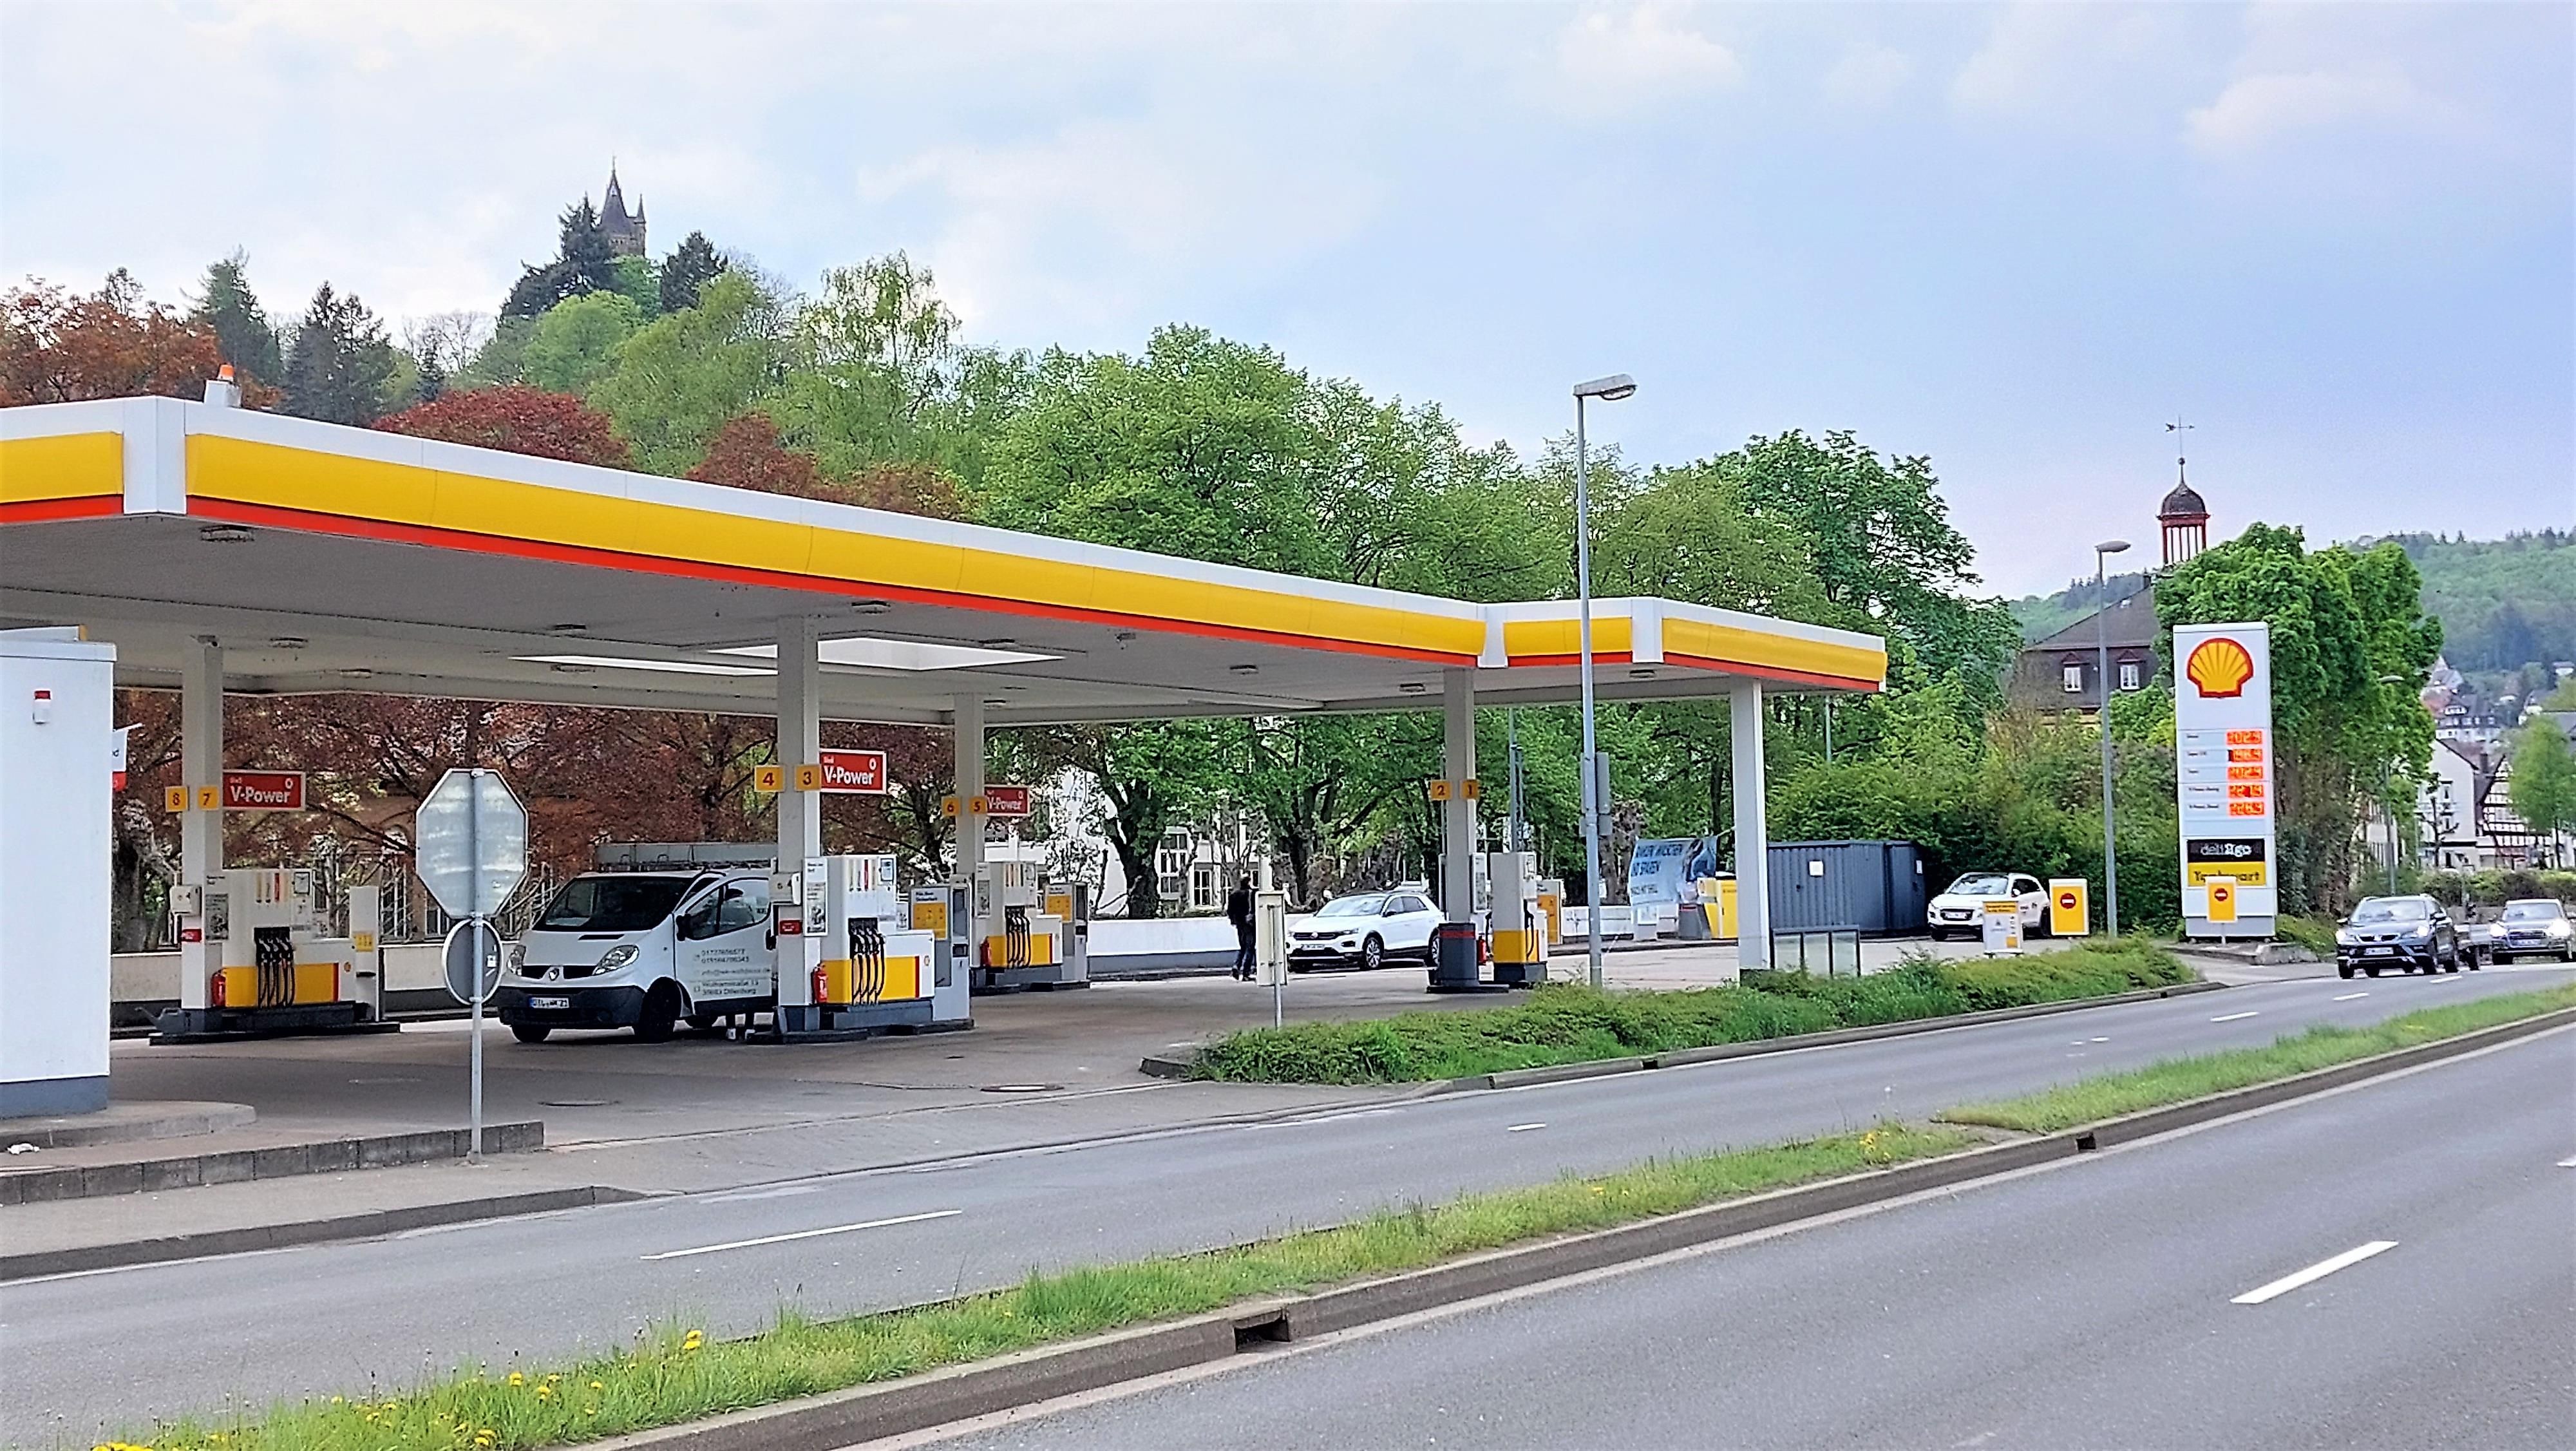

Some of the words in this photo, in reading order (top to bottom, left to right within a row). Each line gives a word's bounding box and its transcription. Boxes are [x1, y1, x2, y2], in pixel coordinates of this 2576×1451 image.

[762, 772, 775, 786] 4
[803, 771, 812, 785] 3
[823, 765, 875, 785] V-Power
[230, 785, 291, 803] V-Power
[1437, 784, 1445, 795] 2
[1468, 784, 1473, 795] 1
[173, 792, 180, 806] 8
[203, 792, 212, 806] 7
[987, 797, 1022, 810] V-Power
[947, 801, 954, 812] 6
[973, 801, 981, 812] 5
